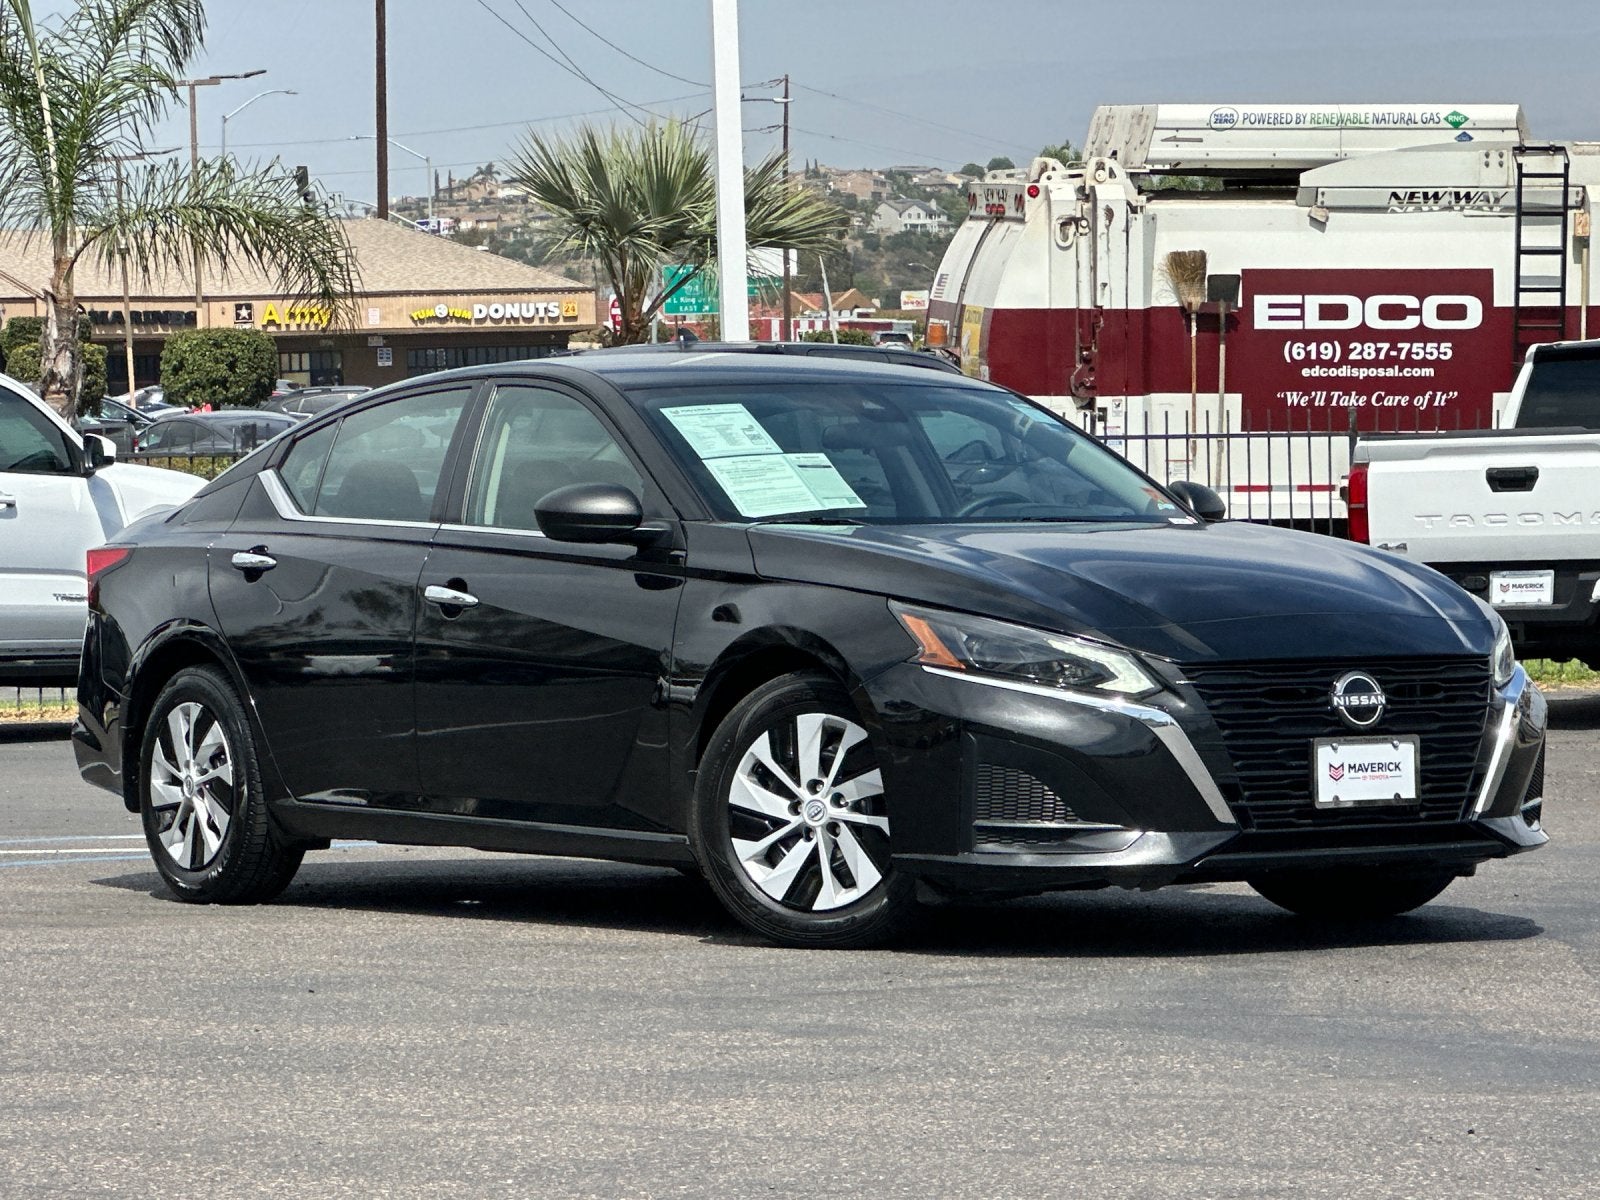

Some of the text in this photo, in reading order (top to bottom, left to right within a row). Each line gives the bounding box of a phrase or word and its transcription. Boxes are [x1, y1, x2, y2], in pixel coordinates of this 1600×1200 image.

[1242, 112, 1441, 126] POWERED BY RENEWABLE NATURAL GAS
[1448, 115, 1465, 123] RNG
[1387, 191, 1508, 204] NEW WAY
[411, 302, 560, 321] YUM YUM DONUTS
[1253, 294, 1483, 329] EDCO
[1283, 341, 1453, 363] (619) 287-7555
[1301, 365, 1435, 379] edcodisposal.com
[1276, 391, 1459, 410] "We'll Take Care of It"
[1333, 695, 1386, 706] NISSAN
[1347, 762, 1402, 774] MAVERICK
